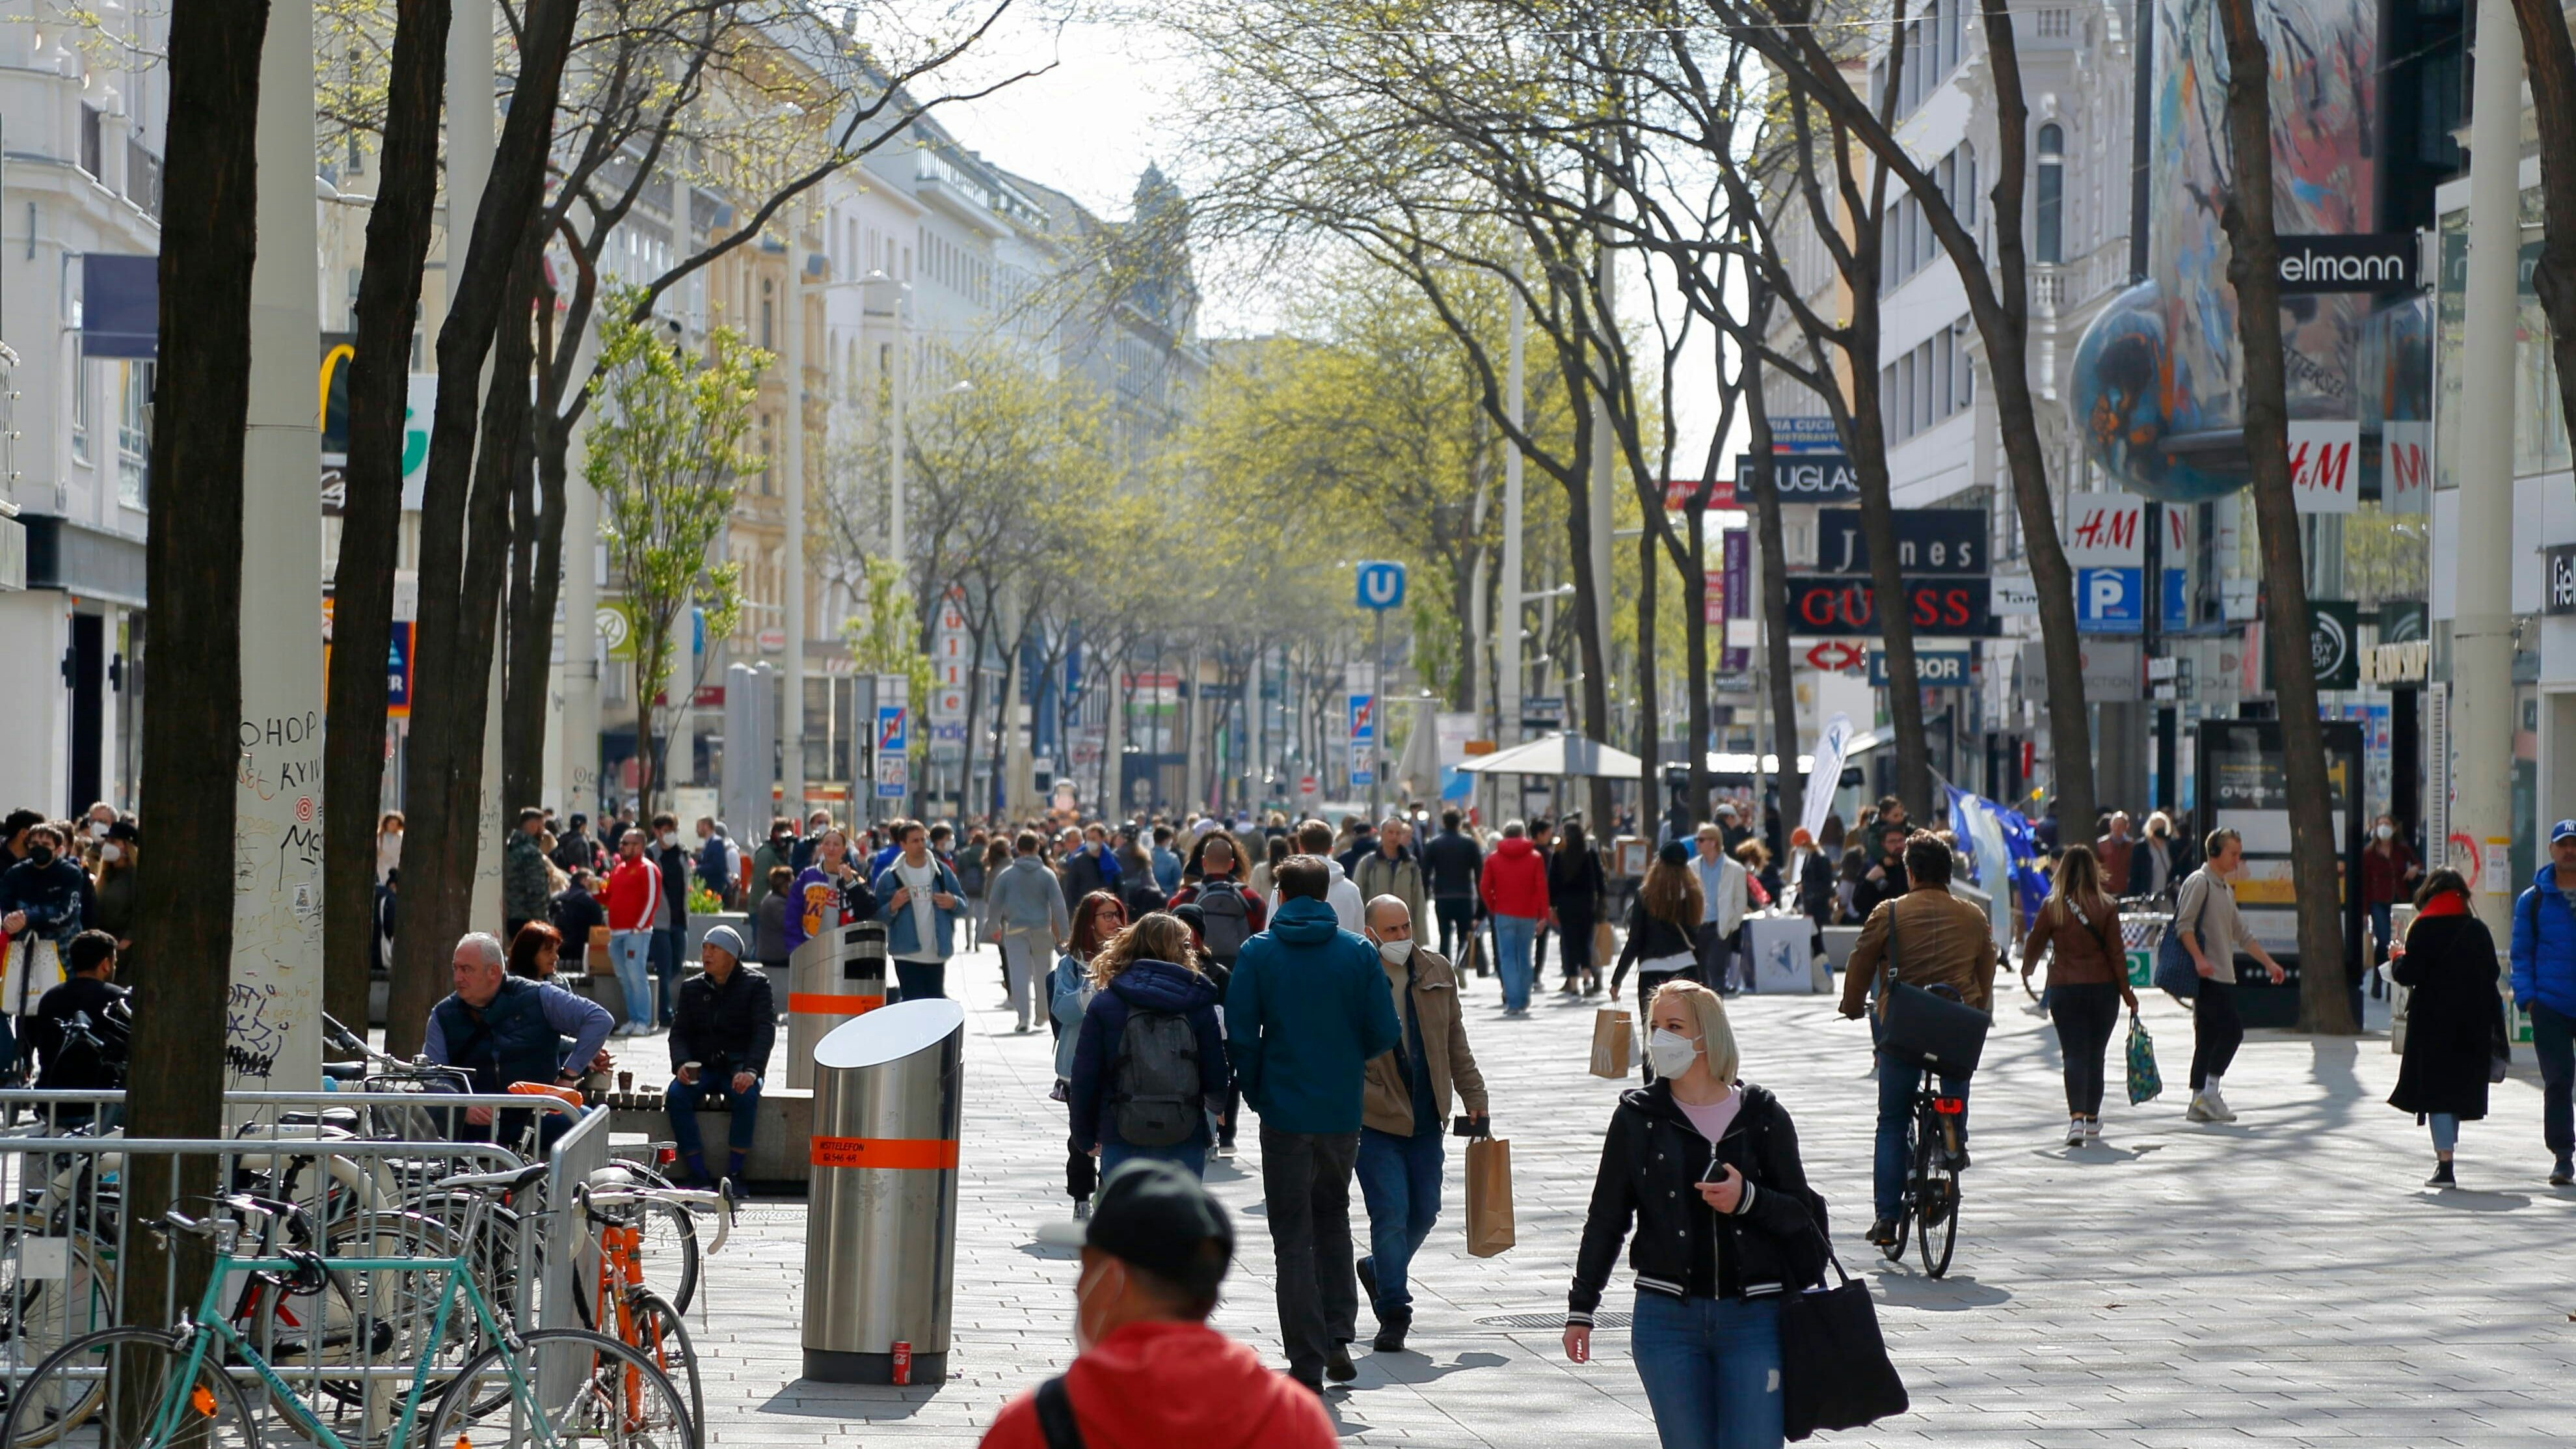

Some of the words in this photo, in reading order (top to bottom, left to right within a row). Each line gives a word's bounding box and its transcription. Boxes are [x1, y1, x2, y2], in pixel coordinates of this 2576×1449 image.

[2279, 248, 2404, 281] elmann
[1738, 465, 1860, 492] DUGLAS
[2074, 508, 2138, 552] H&M
[1834, 529, 1972, 572] Jnes
[1367, 571, 1397, 604] U
[2090, 578, 2124, 619] P
[1801, 588, 1970, 625] GUSS
[2312, 642, 2333, 655] DY
[2312, 656, 2331, 668] OP
[1879, 657, 1960, 679] LBOR
[247, 1348, 300, 1405] Bianchi
[412, 1340, 433, 1392] Bianchi
